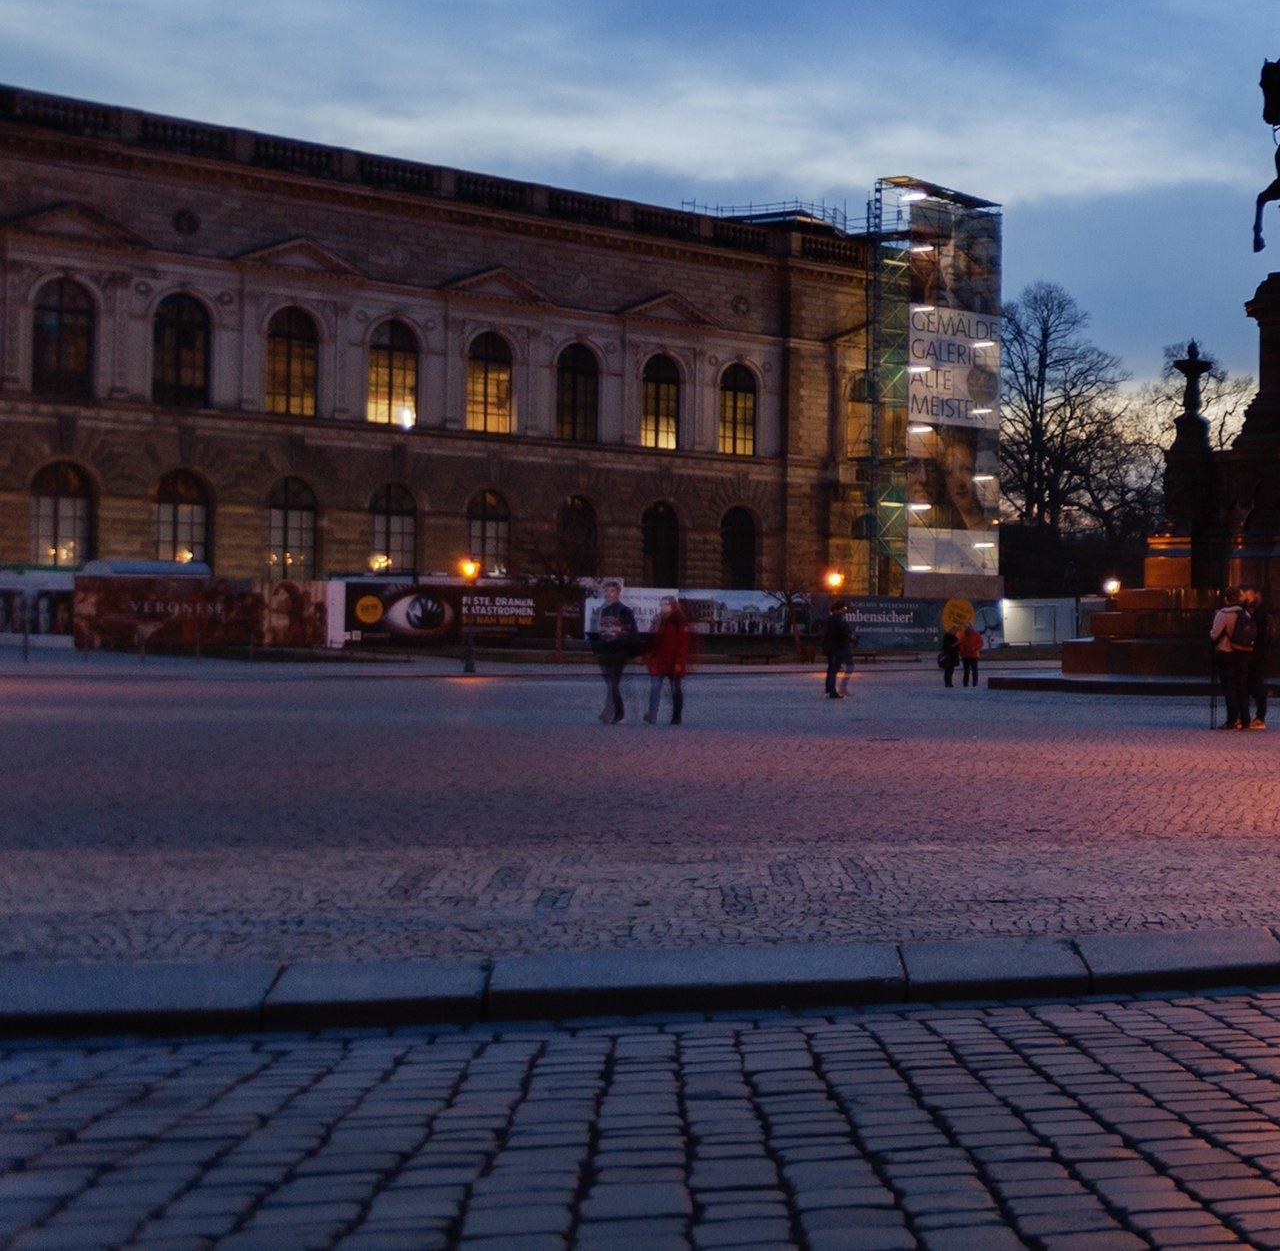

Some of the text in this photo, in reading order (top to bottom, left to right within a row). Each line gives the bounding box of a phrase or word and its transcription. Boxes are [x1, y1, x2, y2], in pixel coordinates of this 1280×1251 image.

[911, 311, 998, 342] GEMÄLDE
[910, 368, 952, 390] ALTE
[128, 600, 225, 615] VERONESE
[843, 609, 914, 623] mbensicher!
